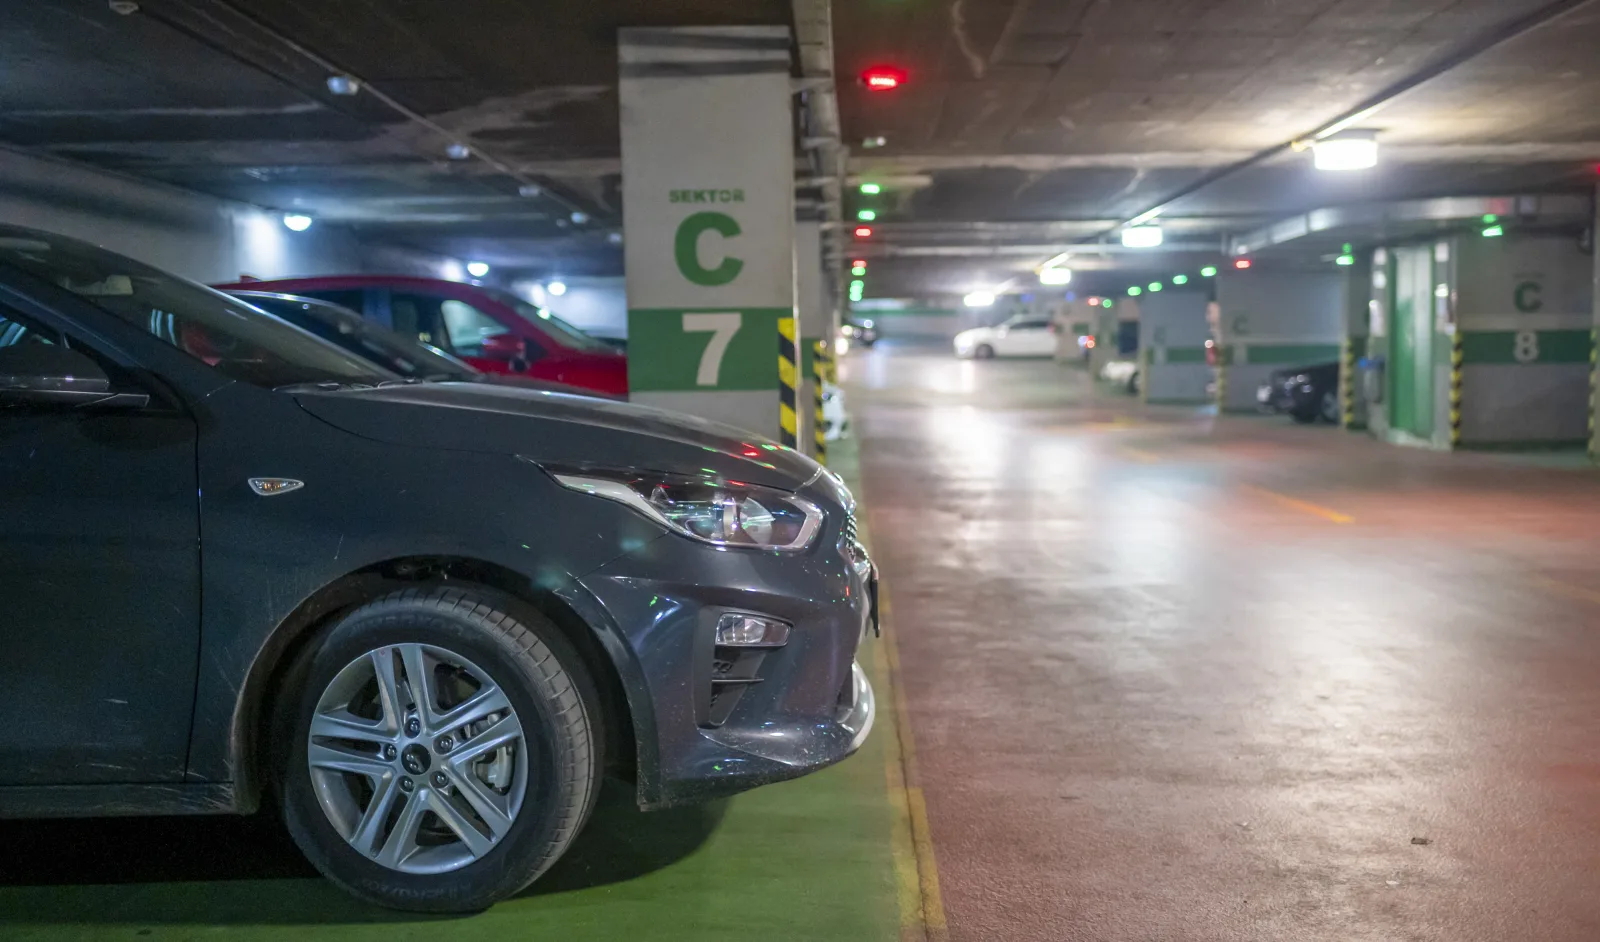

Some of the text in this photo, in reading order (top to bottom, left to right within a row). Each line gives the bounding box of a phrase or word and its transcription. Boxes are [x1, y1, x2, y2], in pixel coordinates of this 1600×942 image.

[669, 189, 745, 203] SEKTOR
[674, 211, 744, 286] C
[1513, 281, 1543, 313] C
[682, 313, 742, 386] 7
[1513, 331, 1539, 362] 8
